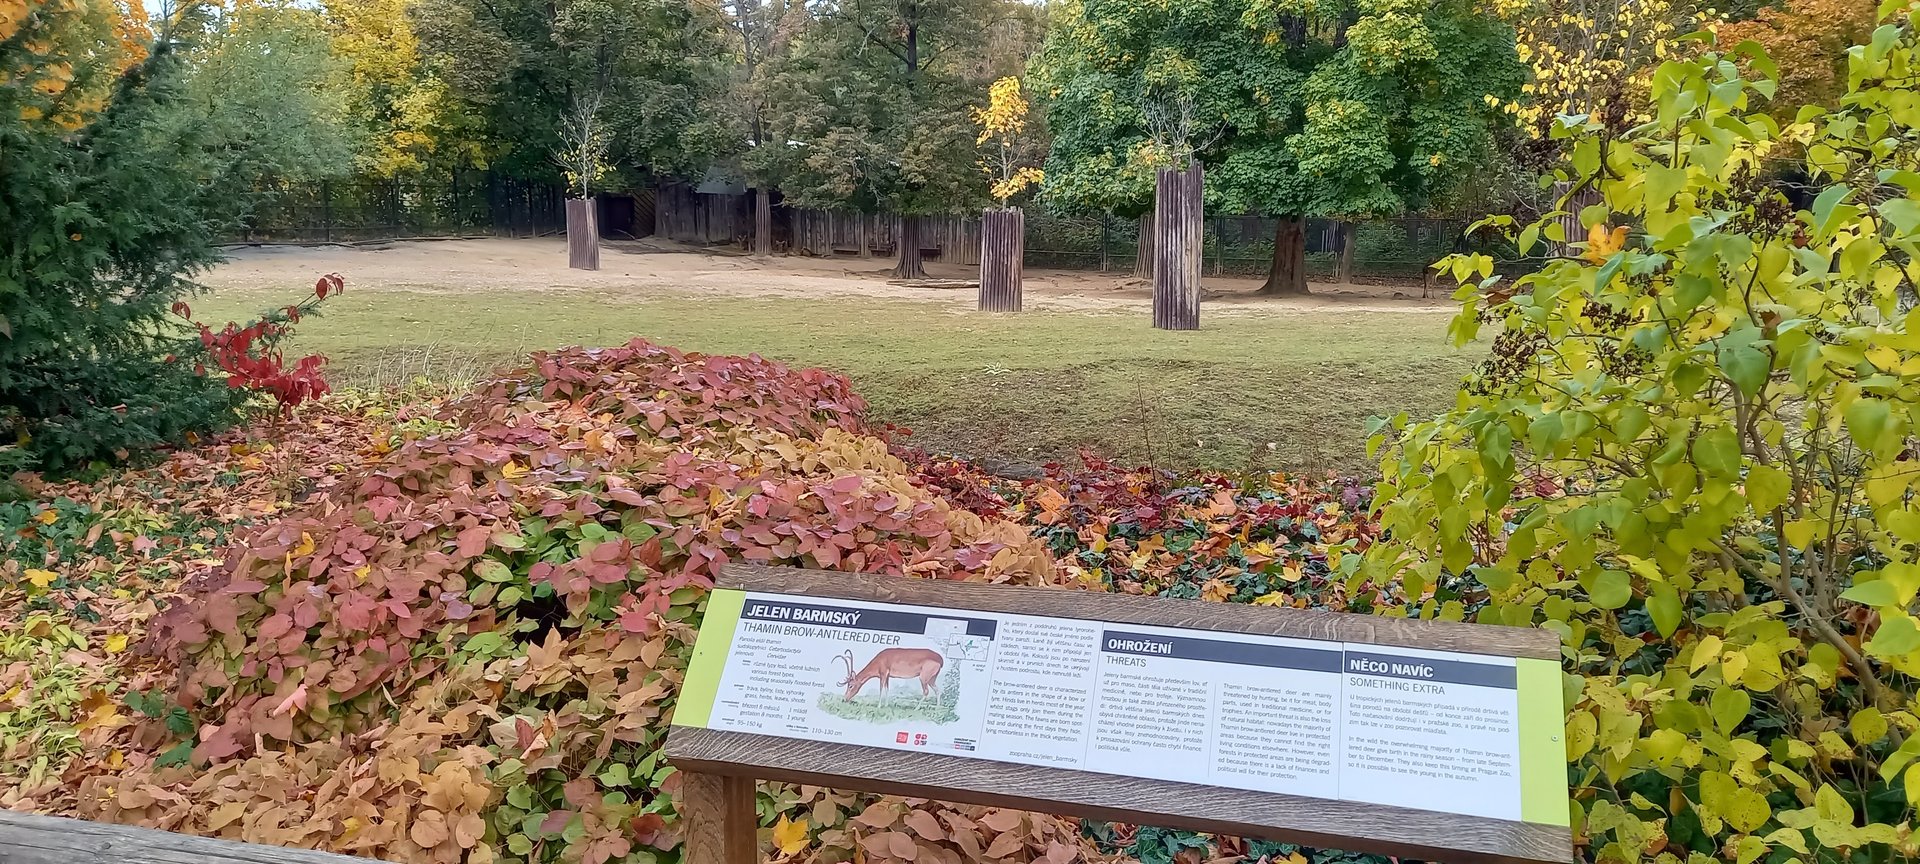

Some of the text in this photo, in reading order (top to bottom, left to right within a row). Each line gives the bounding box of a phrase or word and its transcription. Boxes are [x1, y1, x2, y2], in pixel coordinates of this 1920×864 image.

[747, 604, 861, 626] JELEN BARMSKÝ
[743, 622, 901, 646] THAMIN BROW-ANTLERED DEER
[1107, 638, 1173, 655] OHROŽENÍ
[1106, 655, 1147, 668] THREATS
[1350, 657, 1434, 678] NĚCO NAVÍC
[1349, 677, 1446, 695] SOMETHING EXTRA
